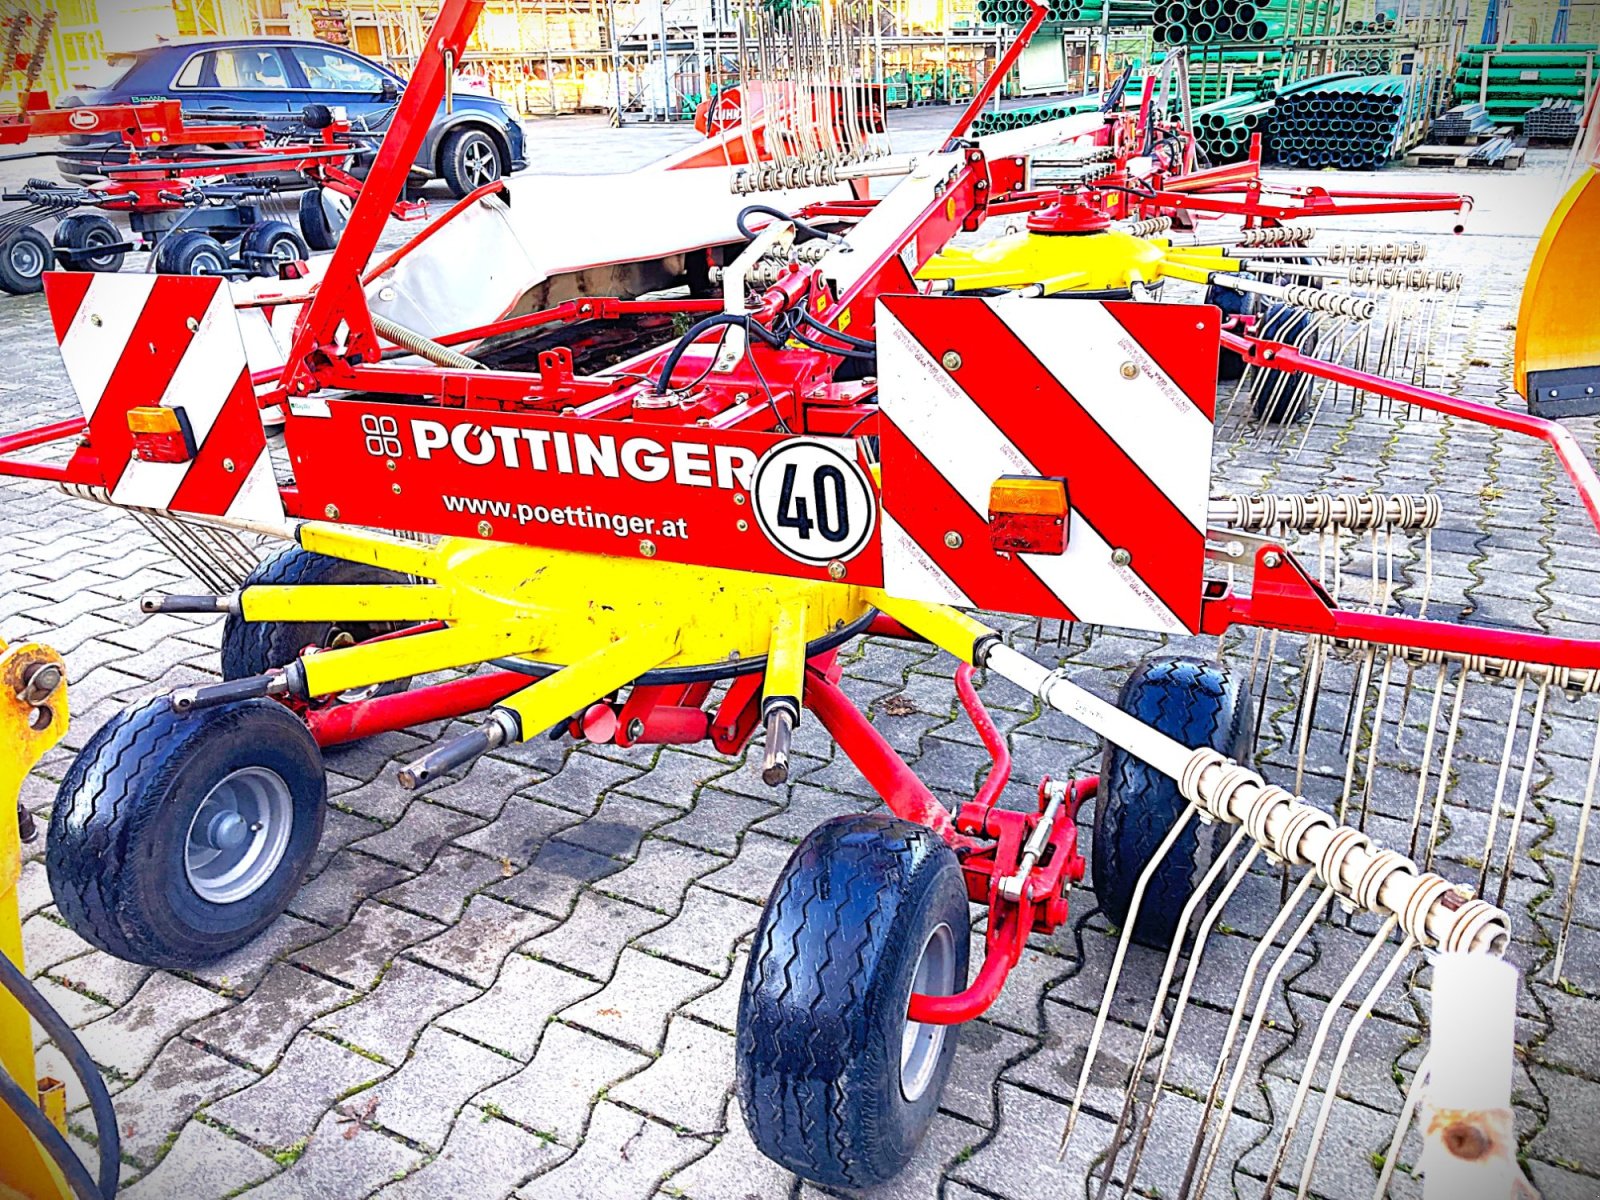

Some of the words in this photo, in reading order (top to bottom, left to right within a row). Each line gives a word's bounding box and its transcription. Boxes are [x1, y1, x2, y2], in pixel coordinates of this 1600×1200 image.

[410, 418, 758, 491] PÖTTINGER
[442, 493, 689, 540] www.poettinger.at
[777, 463, 849, 542] 40
